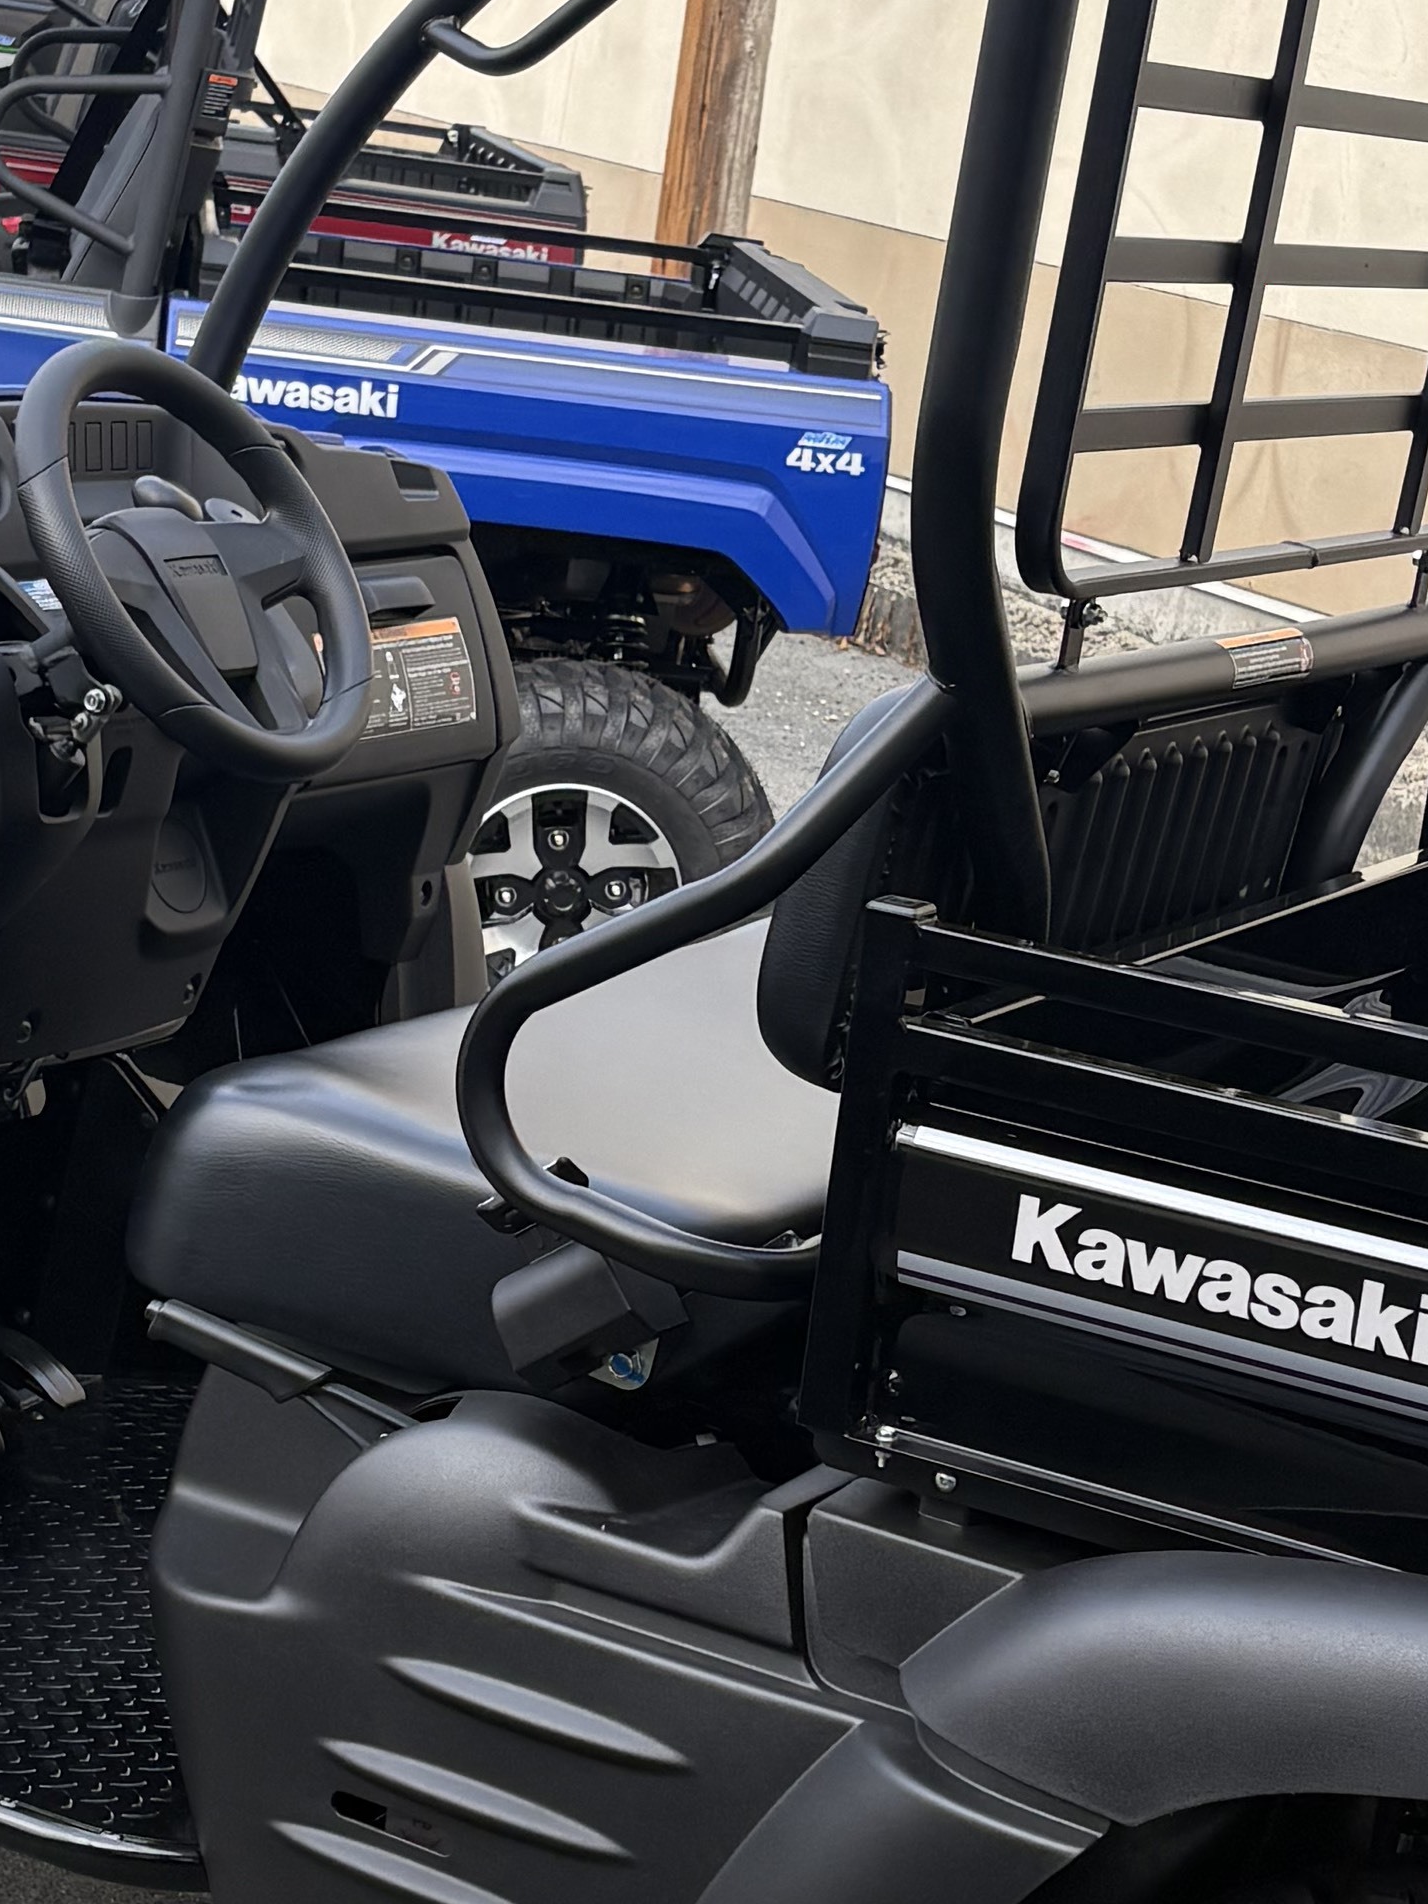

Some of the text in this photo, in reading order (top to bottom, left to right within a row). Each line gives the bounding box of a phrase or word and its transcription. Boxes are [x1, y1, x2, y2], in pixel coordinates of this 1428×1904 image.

[431, 231, 548, 262] Kawasaki
[230, 375, 399, 419] awasaki
[786, 447, 865, 476] 4x4
